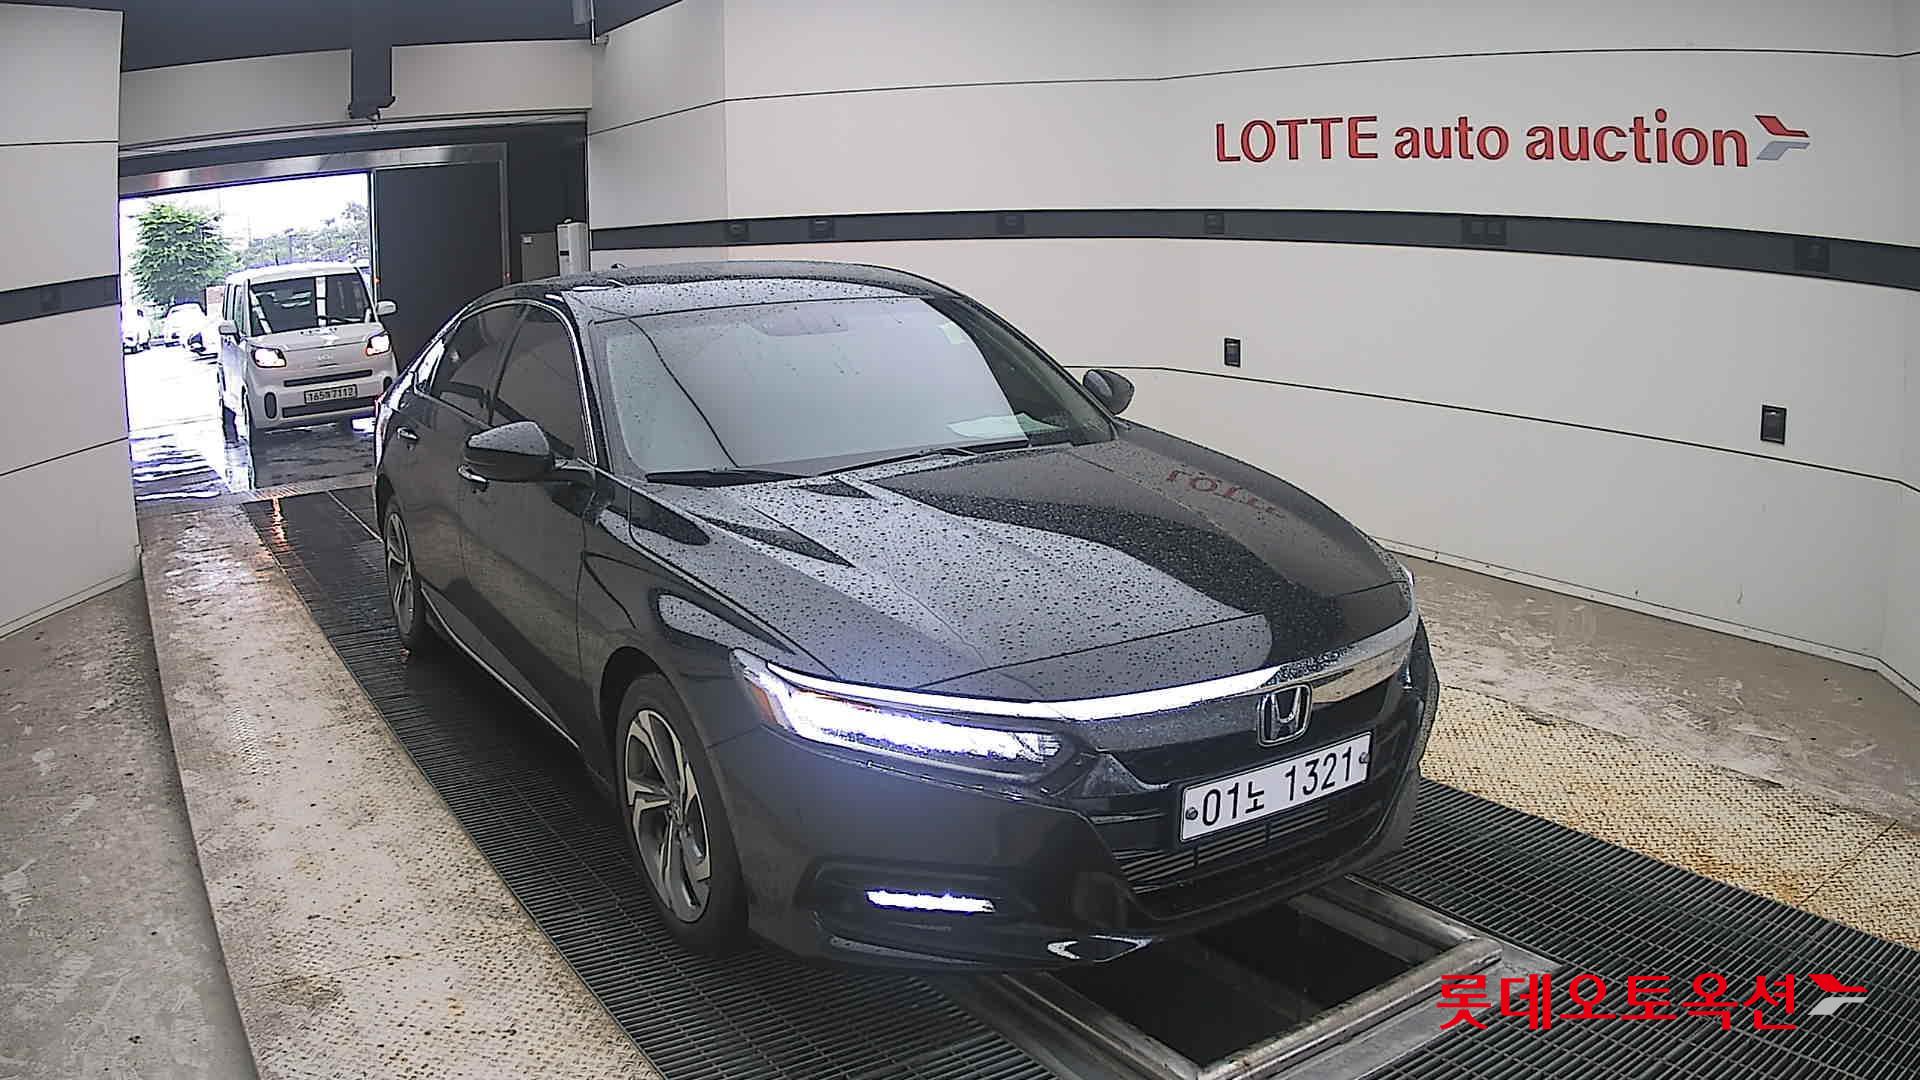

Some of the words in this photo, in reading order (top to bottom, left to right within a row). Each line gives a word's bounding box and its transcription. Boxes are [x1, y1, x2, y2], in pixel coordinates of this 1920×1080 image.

[1215, 115, 1379, 164] LOTTE
[1394, 115, 1509, 161] auto
[1525, 107, 1749, 168] auction
[1202, 781, 1265, 826] 01노
[1285, 746, 1352, 801] 1321
